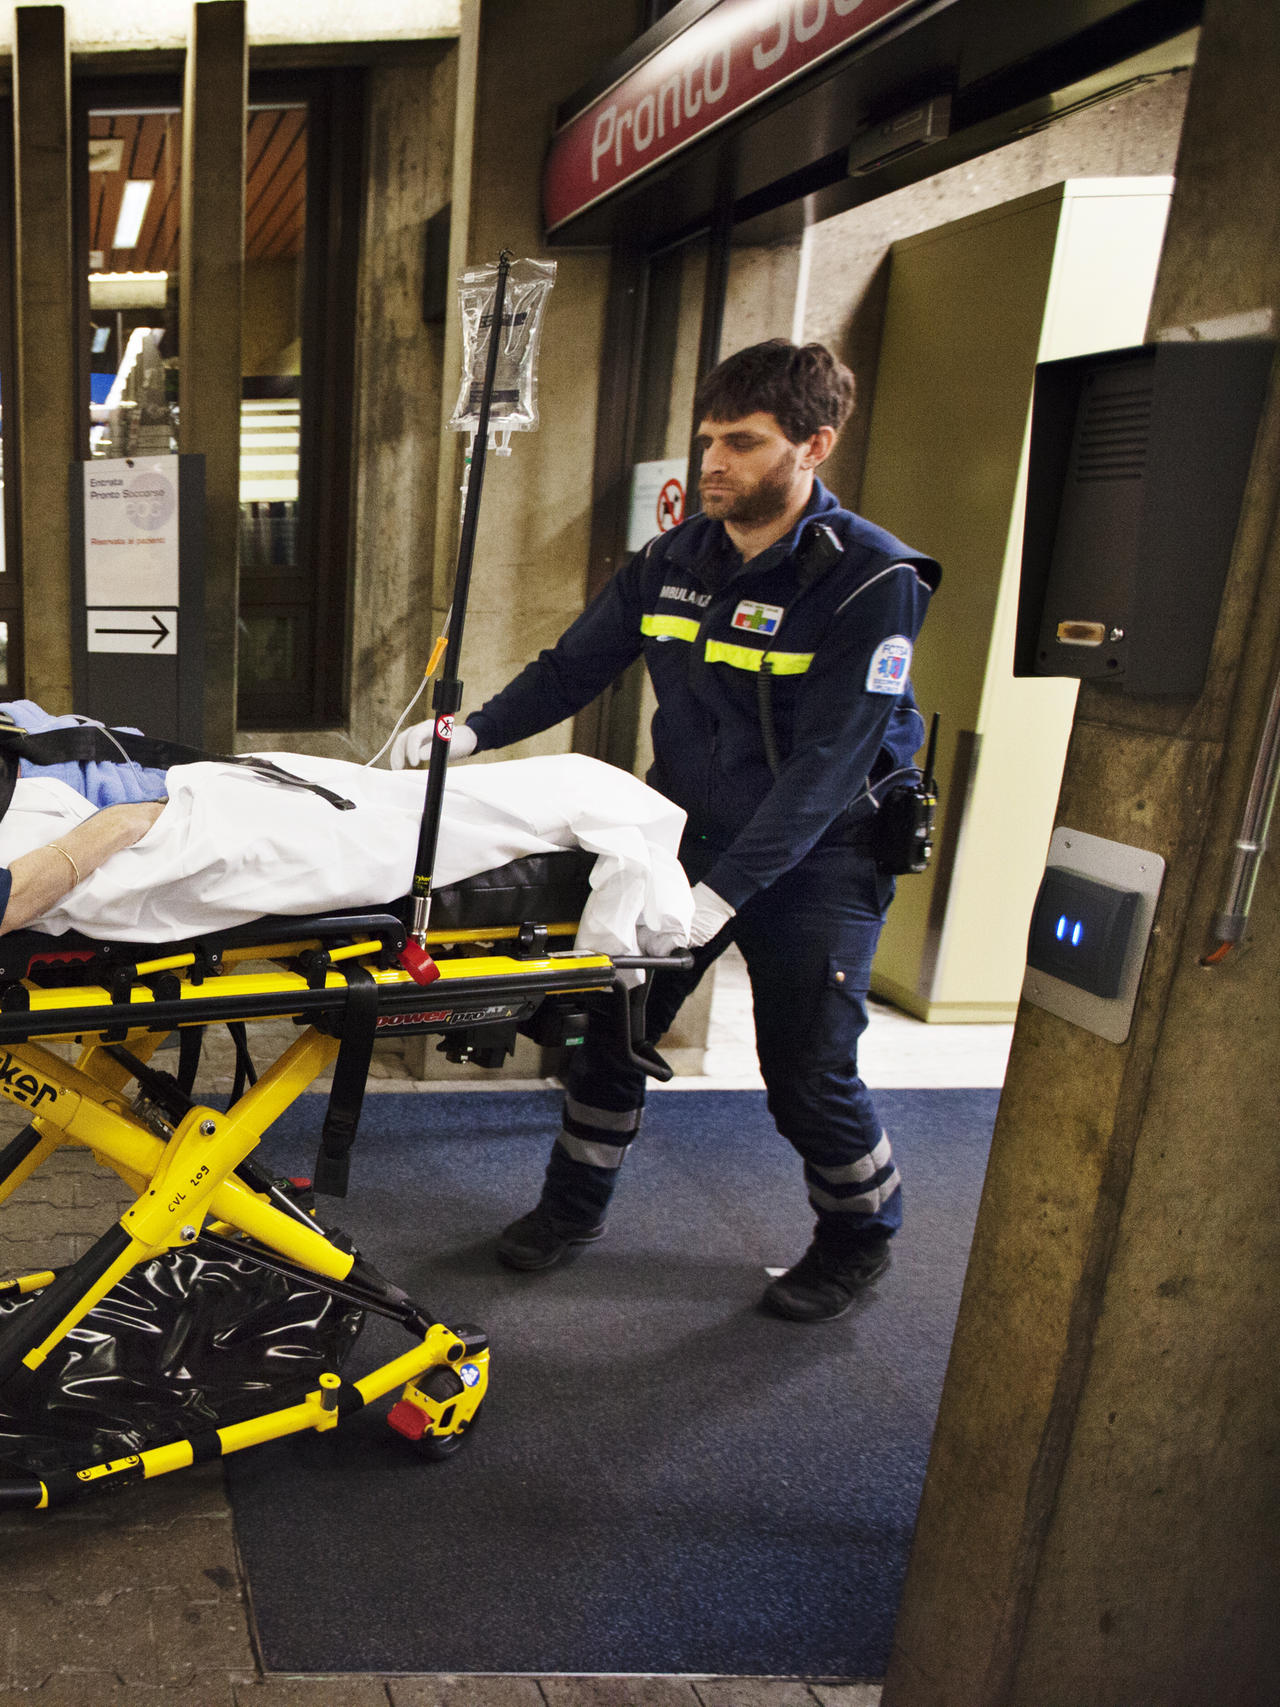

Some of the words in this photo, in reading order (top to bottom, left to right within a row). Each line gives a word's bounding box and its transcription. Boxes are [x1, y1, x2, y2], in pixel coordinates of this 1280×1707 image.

[591, 40, 731, 183] Pronto
[89, 478, 124, 488] Entrata
[89, 490, 121, 500] Pronto
[122, 489, 166, 499] Soccorso
[374, 1008, 453, 1029] power
[450, 1010, 486, 1025] pro
[167, 1192, 187, 1213] CVL
[190, 1164, 210, 1187] 209
